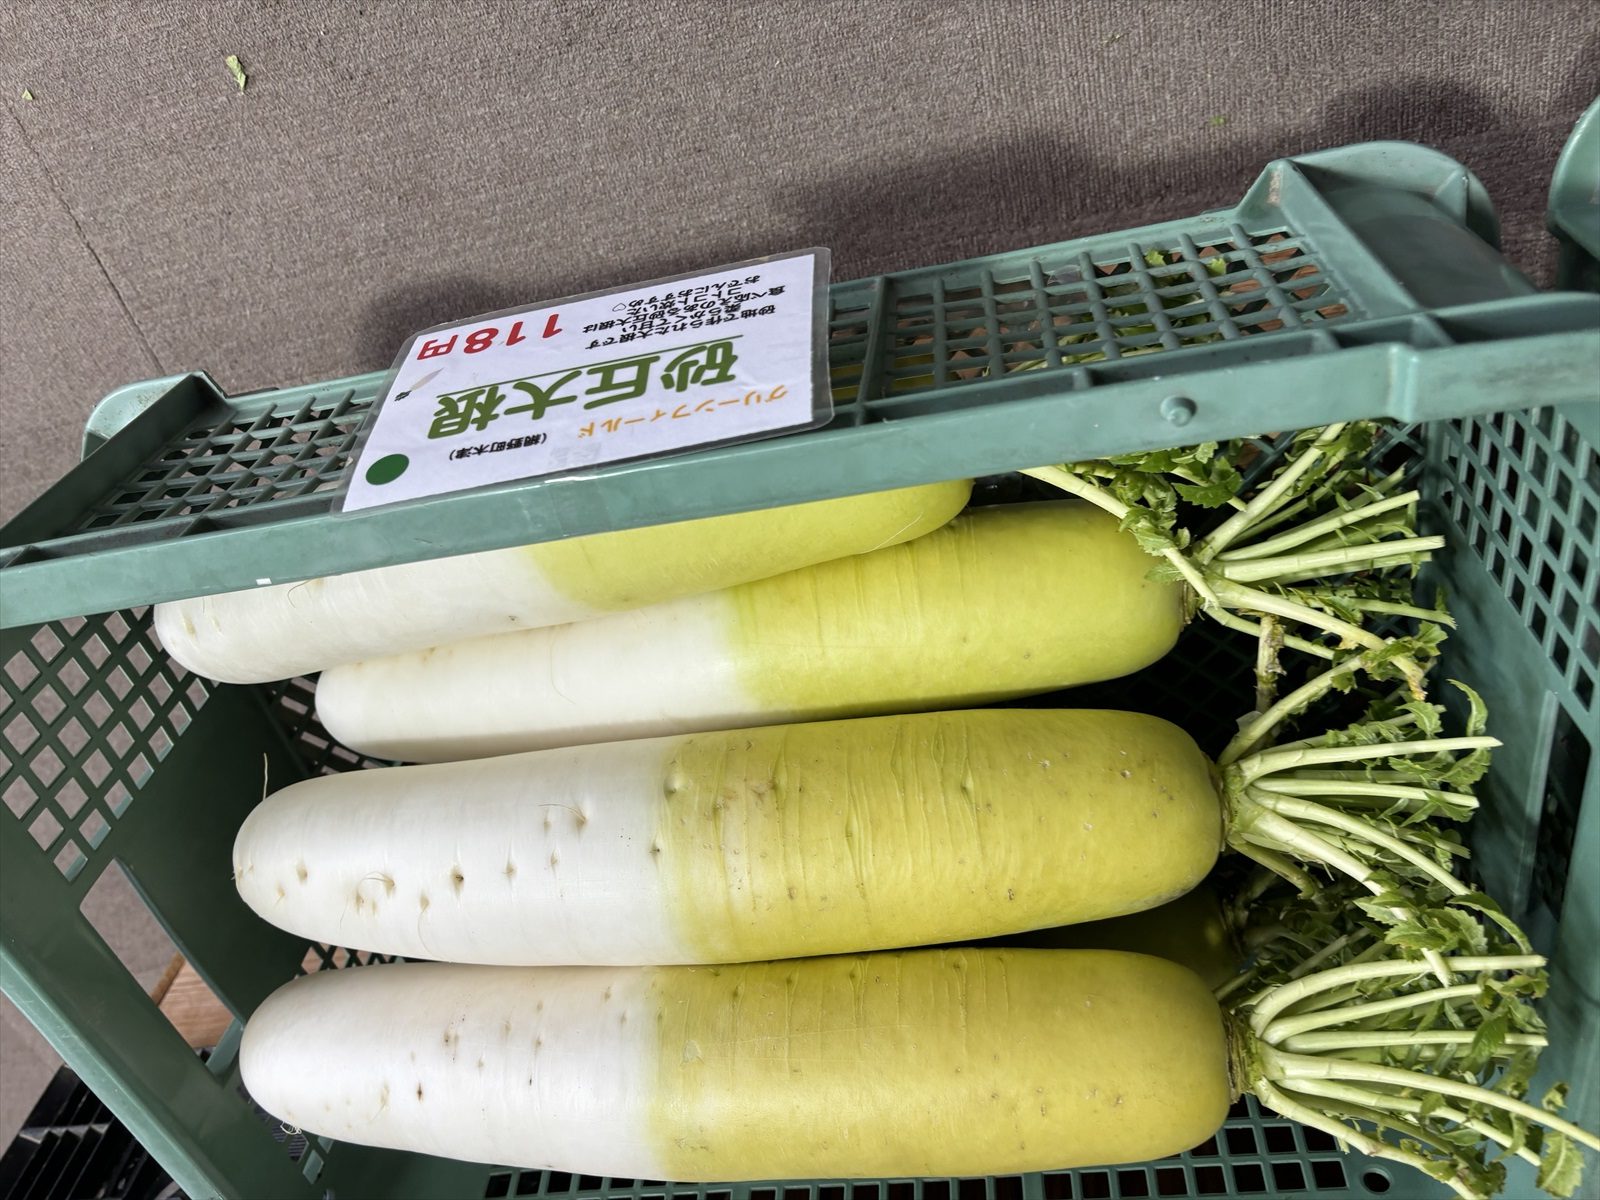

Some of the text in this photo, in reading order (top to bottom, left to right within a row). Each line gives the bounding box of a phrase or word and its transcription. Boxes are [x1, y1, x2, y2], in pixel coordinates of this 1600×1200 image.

[582, 285, 786, 333] 食べ応えのある砂丘大根は
[622, 302, 741, 333] 柔らかくて甘い
[627, 287, 742, 315] コトコト炊いた
[416, 313, 563, 361] 118円
[585, 304, 776, 350] 砂地で作られた大根です
[427, 341, 739, 440] 砂丘大根
[577, 385, 788, 440] グリーンフィールド
